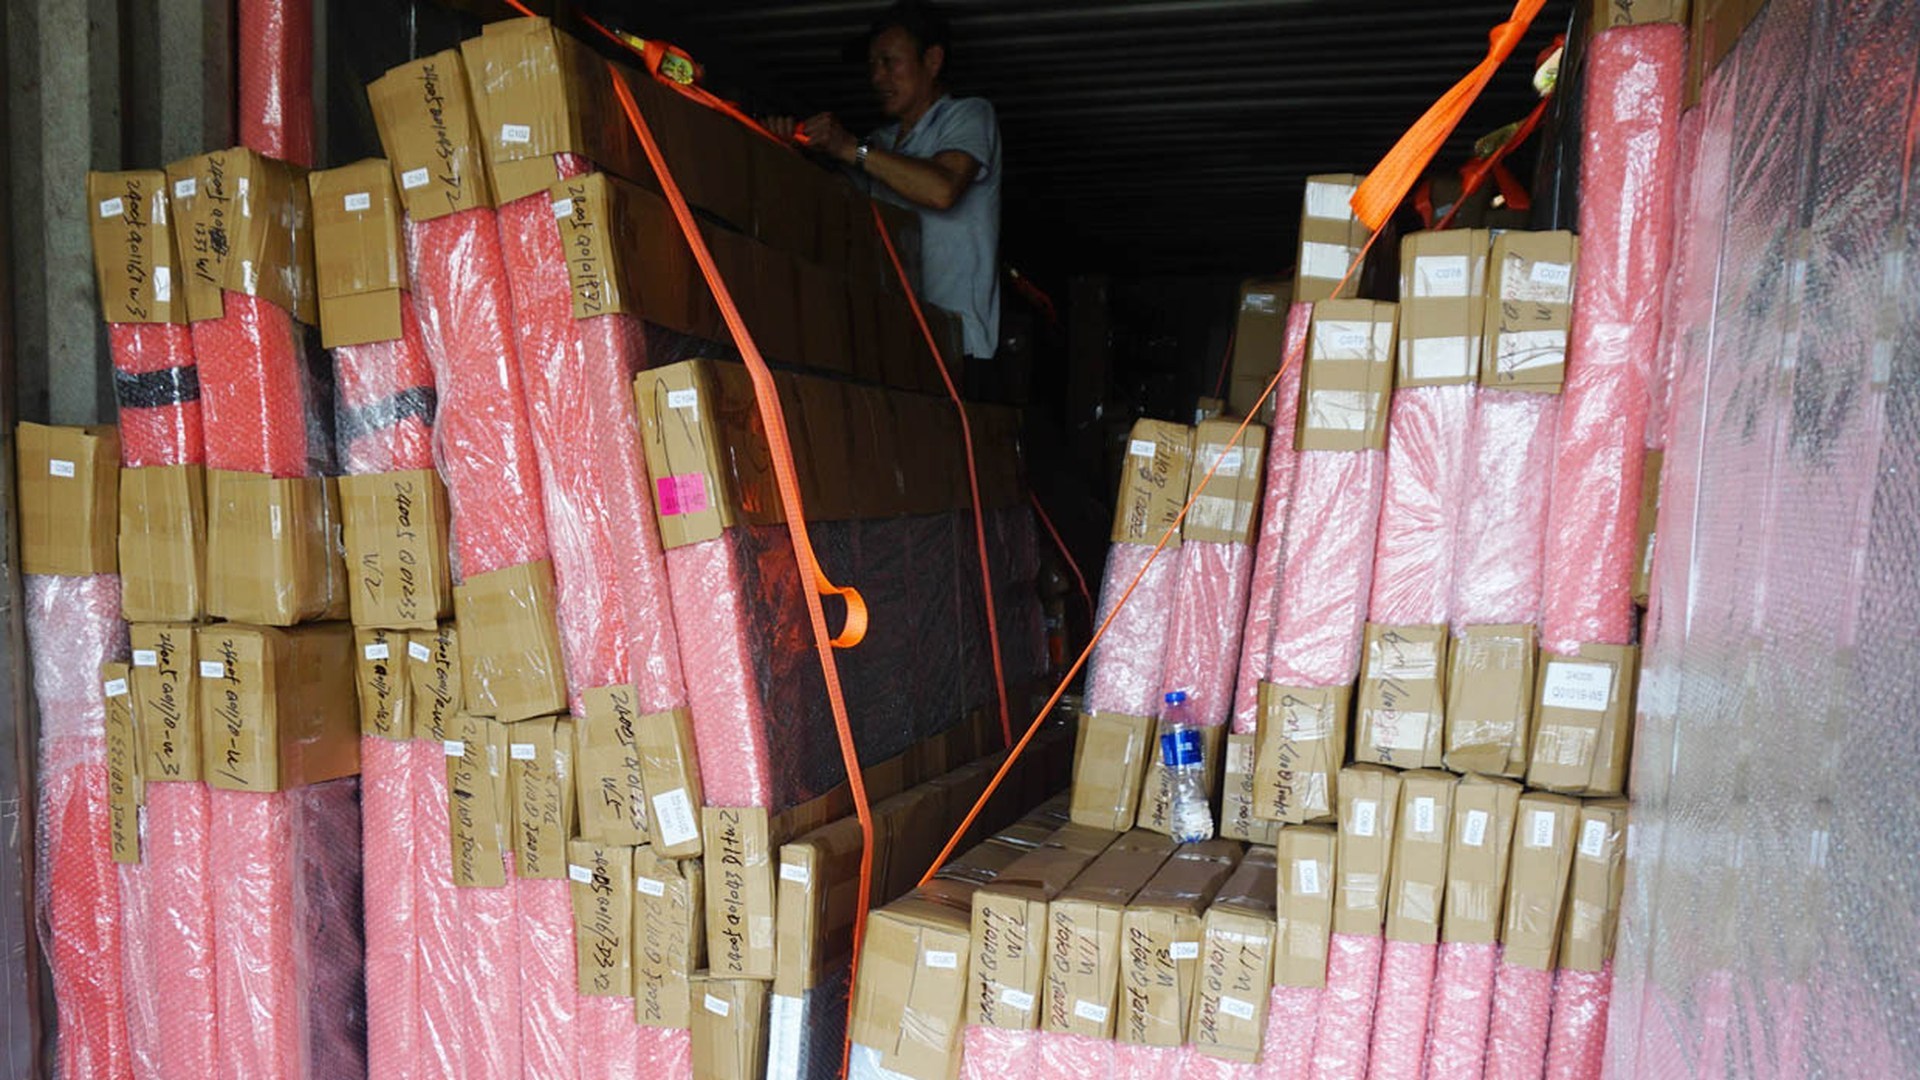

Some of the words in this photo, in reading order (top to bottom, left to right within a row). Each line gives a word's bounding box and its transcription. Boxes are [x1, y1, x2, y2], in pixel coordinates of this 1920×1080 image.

[394, 482, 416, 541] 24005
[154, 633, 178, 682] 24005
[610, 691, 638, 752] 24005
[722, 928, 744, 971] 24005
[1048, 977, 1069, 1027] 24005
